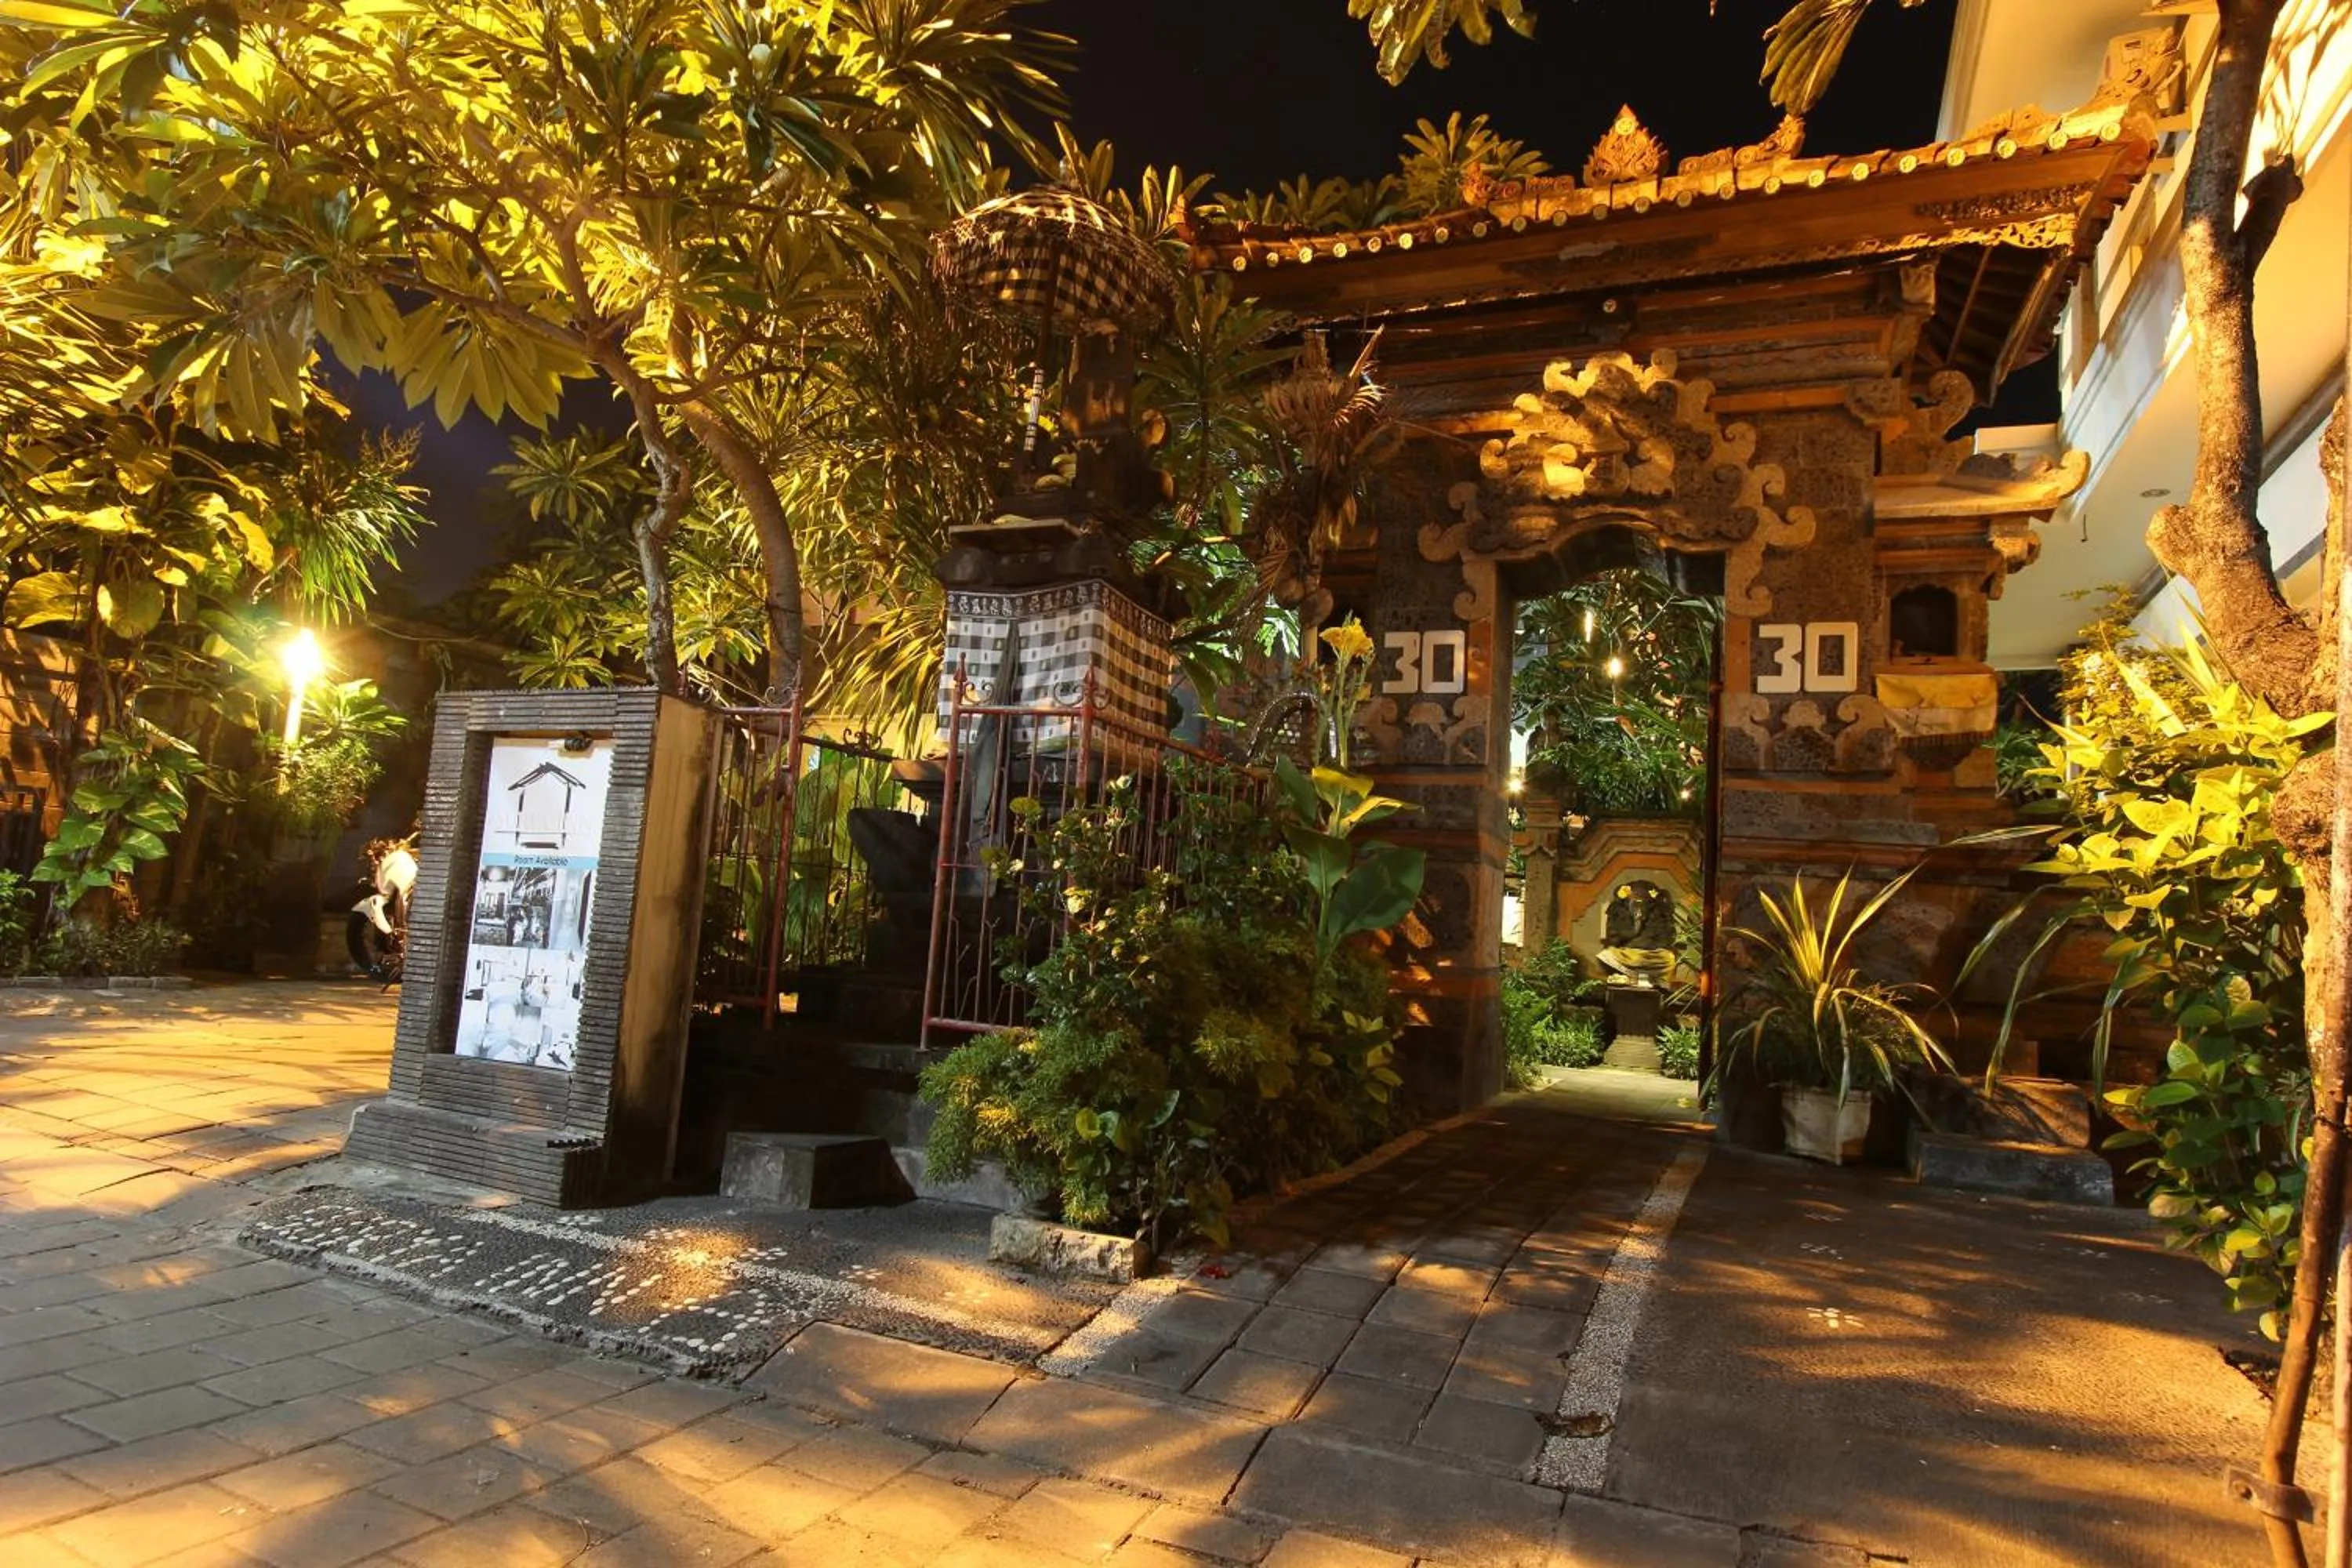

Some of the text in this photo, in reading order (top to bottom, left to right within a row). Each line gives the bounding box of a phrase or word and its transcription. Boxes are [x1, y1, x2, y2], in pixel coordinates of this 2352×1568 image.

[1382, 630, 1465, 693] 30
[1757, 622, 1857, 694] 30
[514, 855, 568, 866] Room Available
